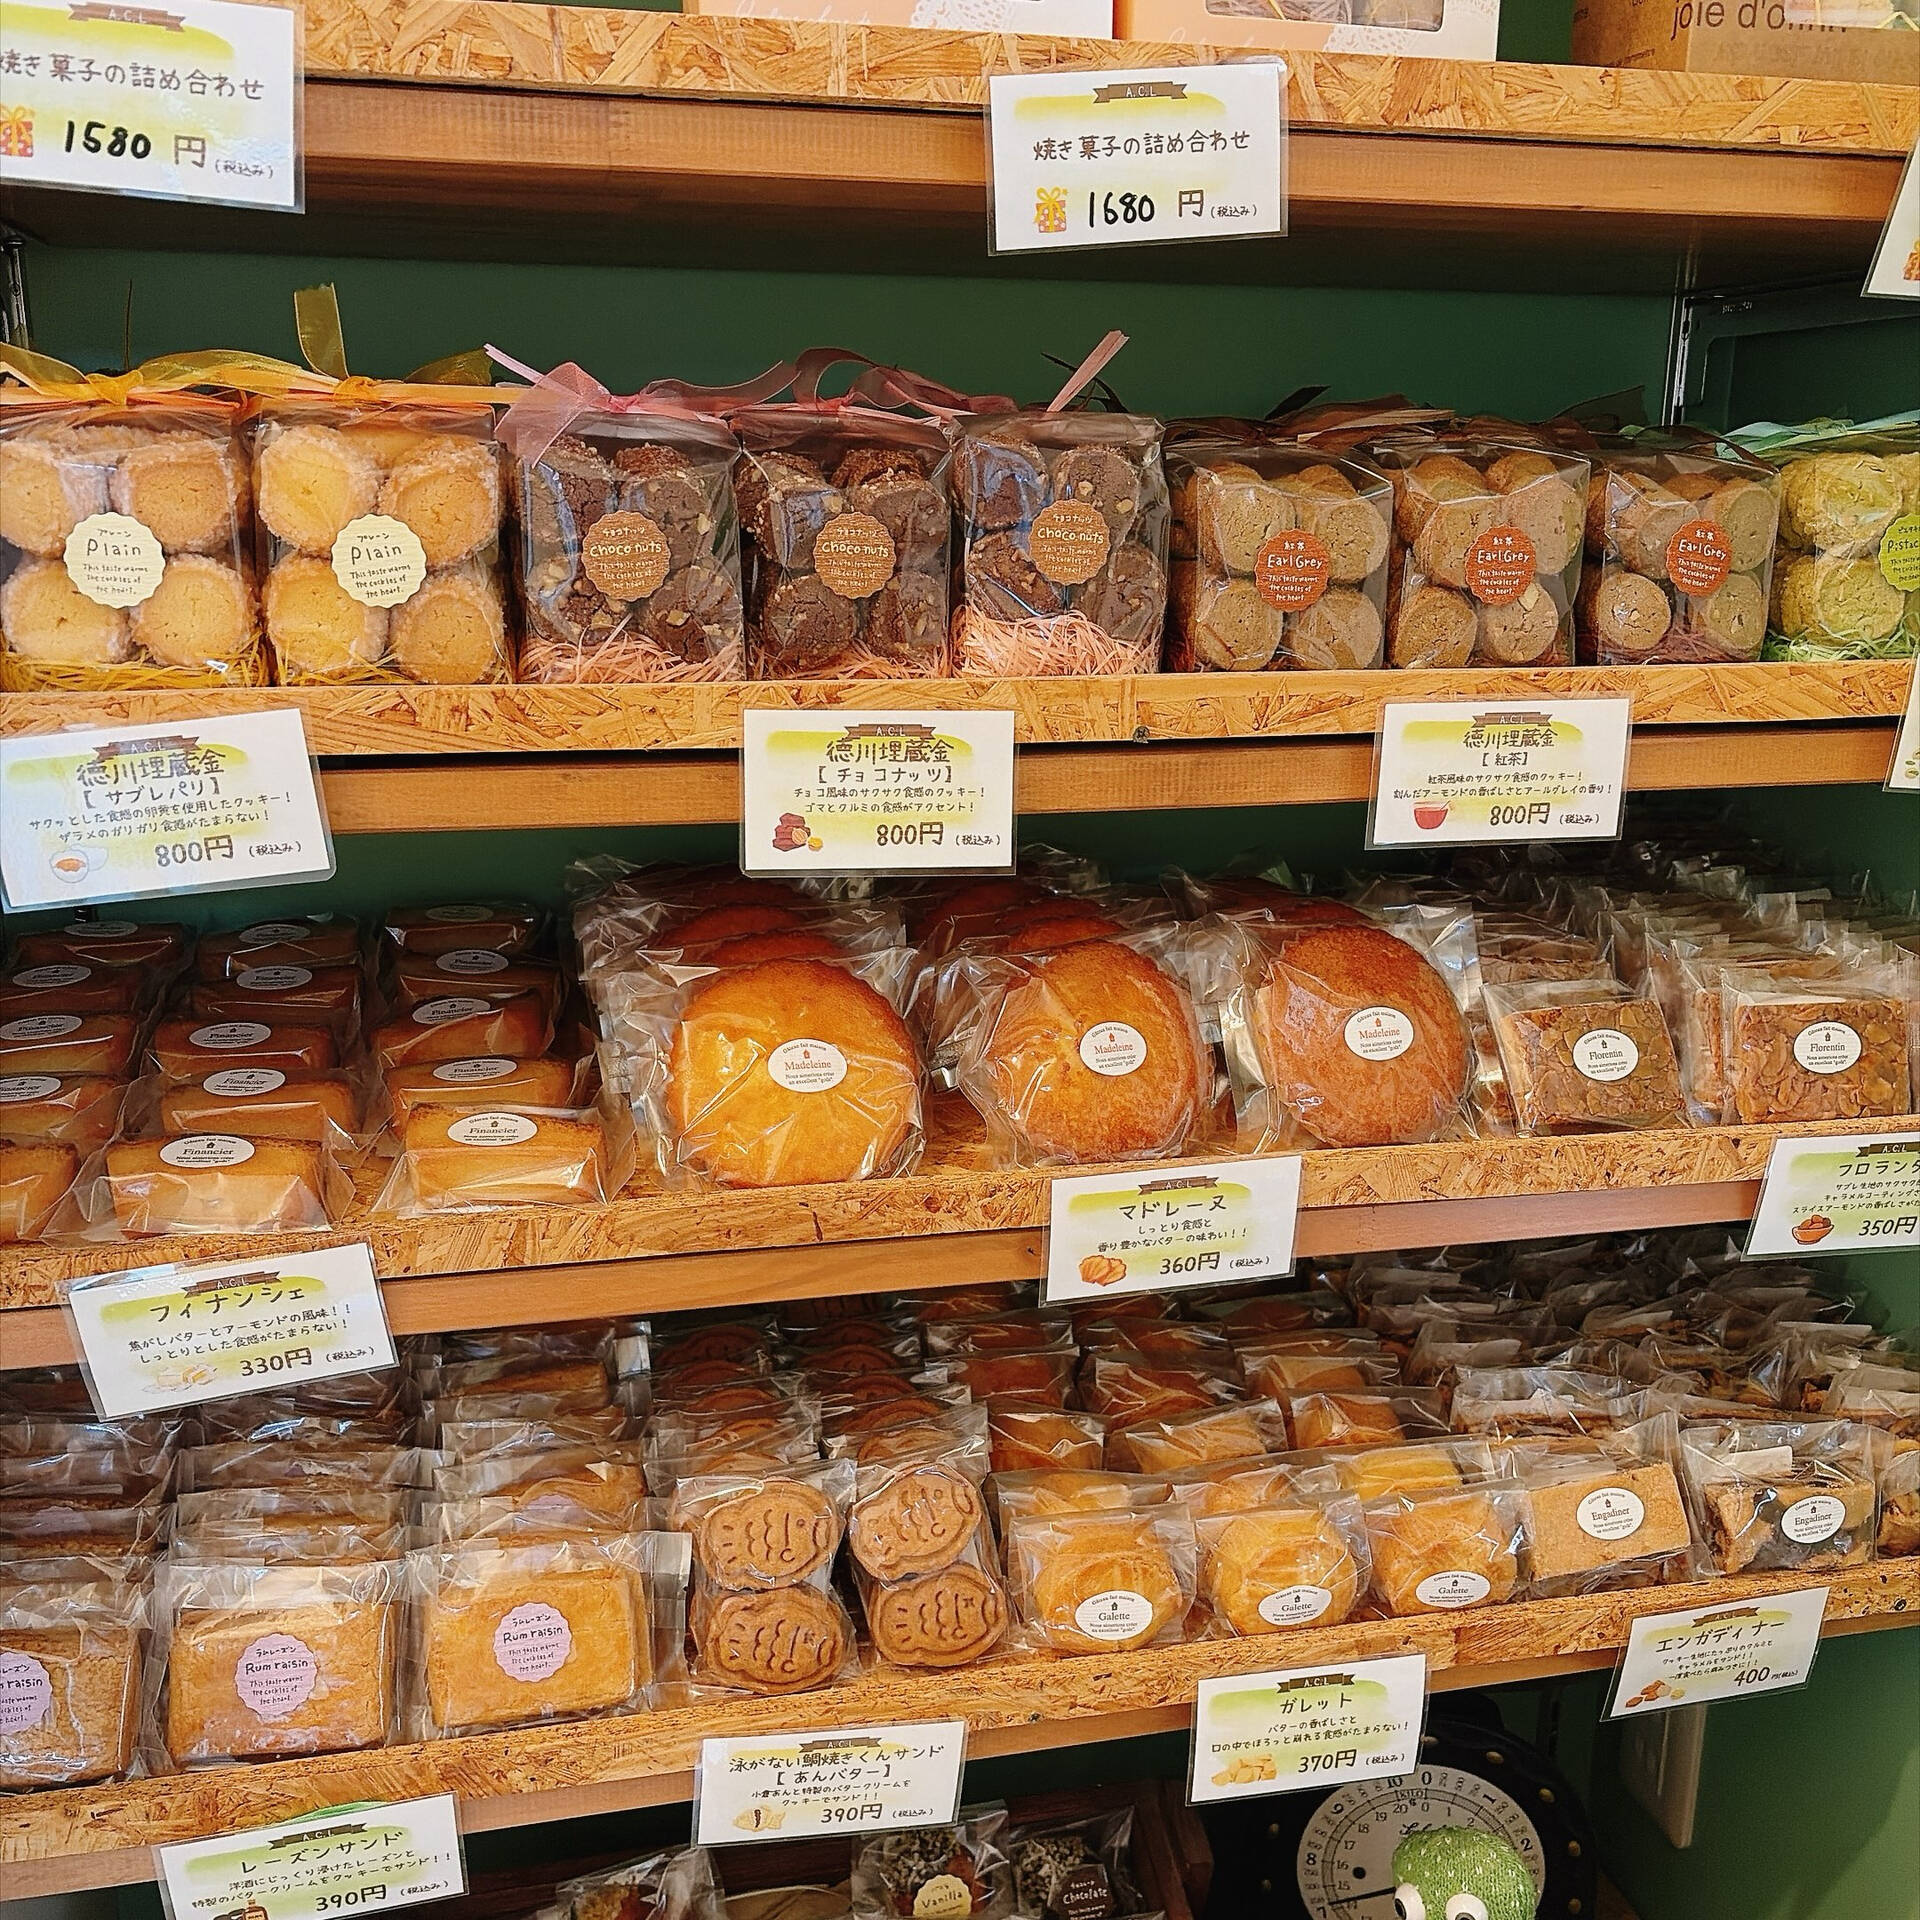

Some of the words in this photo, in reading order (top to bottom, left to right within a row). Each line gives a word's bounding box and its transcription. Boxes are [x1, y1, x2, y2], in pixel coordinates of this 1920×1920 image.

[65, 120, 152, 160] 1580
[174, 134, 206, 168] 円
[1033, 130, 1250, 161] 焼き菓子の詰め合わせ
[1089, 191, 1155, 228] 1680
[1178, 189, 1204, 217] 円
[1078, 531, 1104, 545] nuts
[86, 539, 142, 556] Plain
[351, 546, 402, 565] Plain
[635, 541, 662, 554] nuts
[863, 543, 889, 558] nuts
[1678, 538, 1702, 554] Earl
[1703, 543, 1727, 561] Grey
[1267, 554, 1293, 569] Earl
[1295, 556, 1323, 571] Grey
[1477, 550, 1502, 564] Earl
[1503, 550, 1530, 565] Grey
[1463, 728, 1558, 750] 徳川埋蔵金
[826, 738, 954, 766] 徳川埋蔵金
[1482, 751, 1528, 767] 【紅茶】
[77, 749, 225, 787] 徳川埋蔵金
[818, 765, 953, 783] 【チョコナッツ】
[84, 783, 221, 810] 【サブレパリ】
[1489, 803, 1551, 827] 800円
[876, 822, 943, 847] 800円
[155, 834, 234, 867] 800円
[1359, 1028, 1401, 1039] Madeleine
[1094, 1043, 1134, 1054] Madeleine
[1588, 1049, 1624, 1061] Florentin
[1810, 1042, 1846, 1053] Florentin
[784, 1060, 832, 1071] Madeleine
[1119, 1194, 1227, 1222] マドレーヌ
[1138, 1219, 1213, 1236] しっとり食感と
[1859, 1216, 1918, 1237] 350円
[1160, 1252, 1220, 1275] 360円
[149, 1287, 305, 1324] フィナンシェ
[240, 1347, 312, 1377] 330円
[1592, 1507, 1630, 1521] Engadiner
[1794, 1511, 1832, 1525] Engadiner
[1438, 1586, 1470, 1595] Galette
[1281, 1602, 1312, 1612] Galette
[1098, 1611, 1130, 1622] Galette
[503, 1631, 528, 1645] Rum
[531, 1627, 564, 1640] raisin
[1655, 1620, 1785, 1653] エンガディナー
[245, 1662, 273, 1676] Rum
[274, 1659, 309, 1672] raisin
[1734, 1666, 1771, 1687] 400
[7, 1678, 43, 1690] raisin
[1279, 1692, 1353, 1716] ガレット
[1268, 1715, 1357, 1734] バターの香ばしさと
[729, 1744, 945, 1774] 泳がない鯛焼きくんサンド
[1297, 1749, 1357, 1774] 370円
[776, 1764, 891, 1787] 【あんバター】
[1387, 1776, 1403, 1789] 10
[1421, 1771, 1433, 1785] 0
[820, 1803, 883, 1826] 390円
[1331, 1802, 1344, 1816] 9
[1375, 1811, 1388, 1822] 19
[1392, 1803, 1408, 1815] 20
[1357, 1823, 1370, 1834] 18
[240, 1830, 404, 1875] レーズンサンド
[1343, 1840, 1355, 1850] 17
[1306, 1853, 1318, 1866] 8
[315, 1884, 387, 1914] 390円
[922, 1891, 963, 1909] Vanilla
